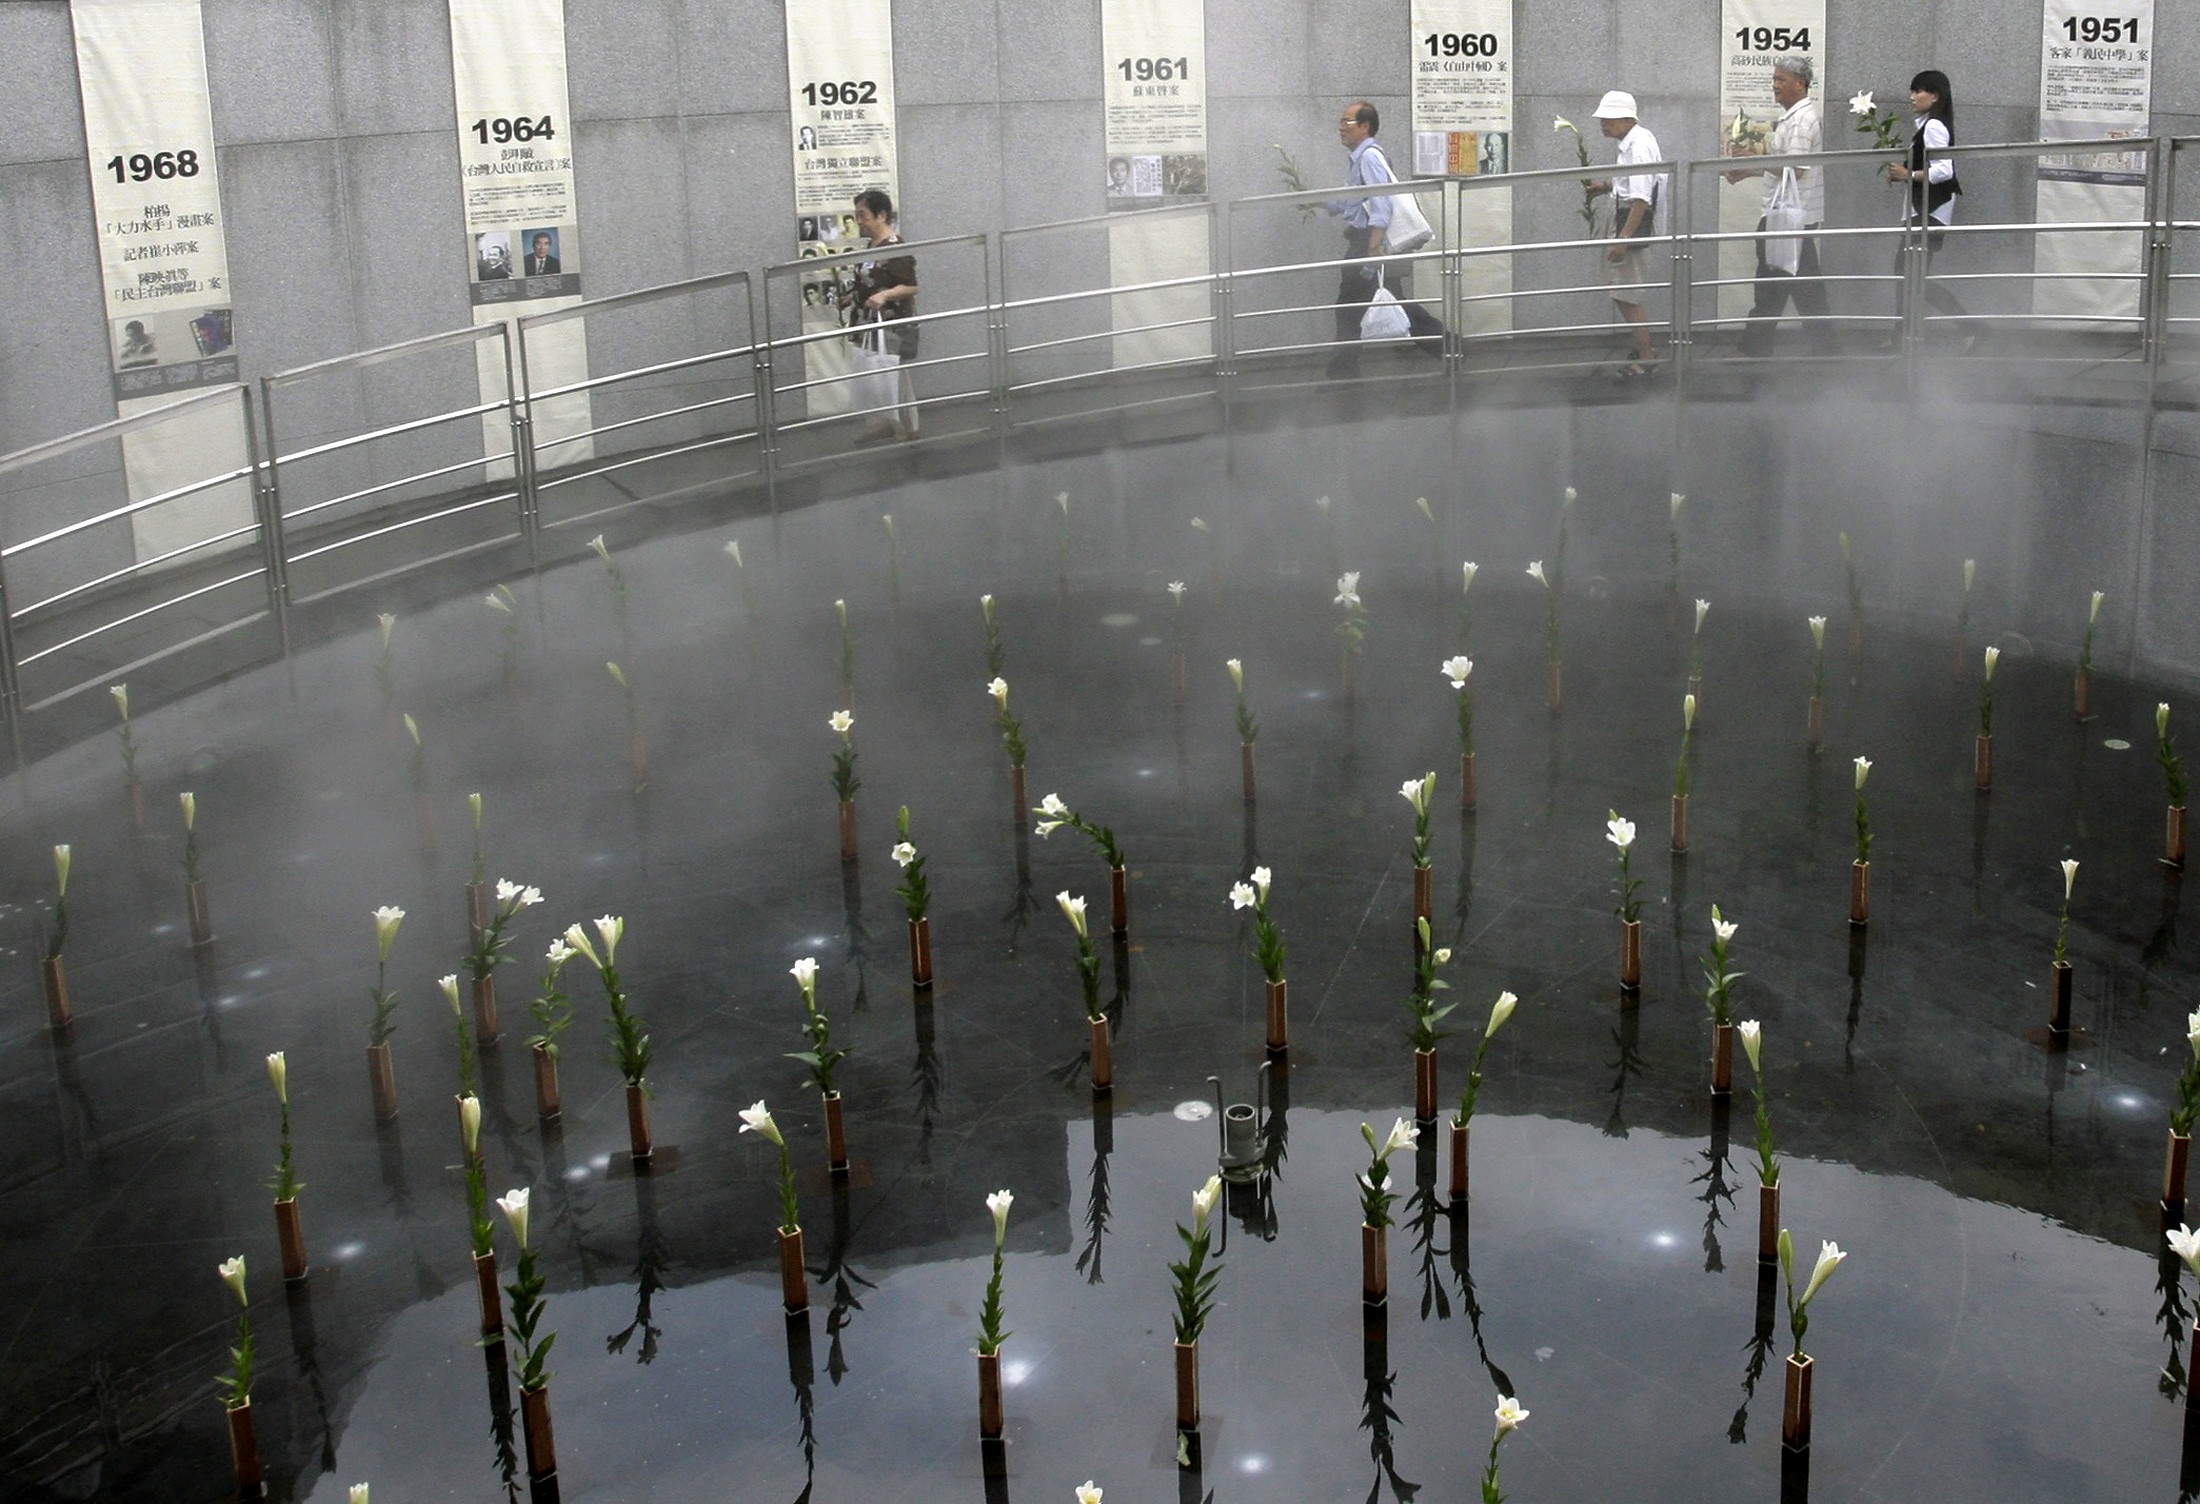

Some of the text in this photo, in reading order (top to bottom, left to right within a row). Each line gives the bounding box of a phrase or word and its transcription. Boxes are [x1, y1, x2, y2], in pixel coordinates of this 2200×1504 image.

[1736, 27, 1811, 51] 1954
[2063, 17, 2138, 43] 1951
[1425, 33, 1498, 57] 1960
[1118, 57, 1188, 81] 1961
[801, 81, 877, 106] 1962
[472, 115, 555, 144] 1964
[107, 149, 200, 184] 1968
